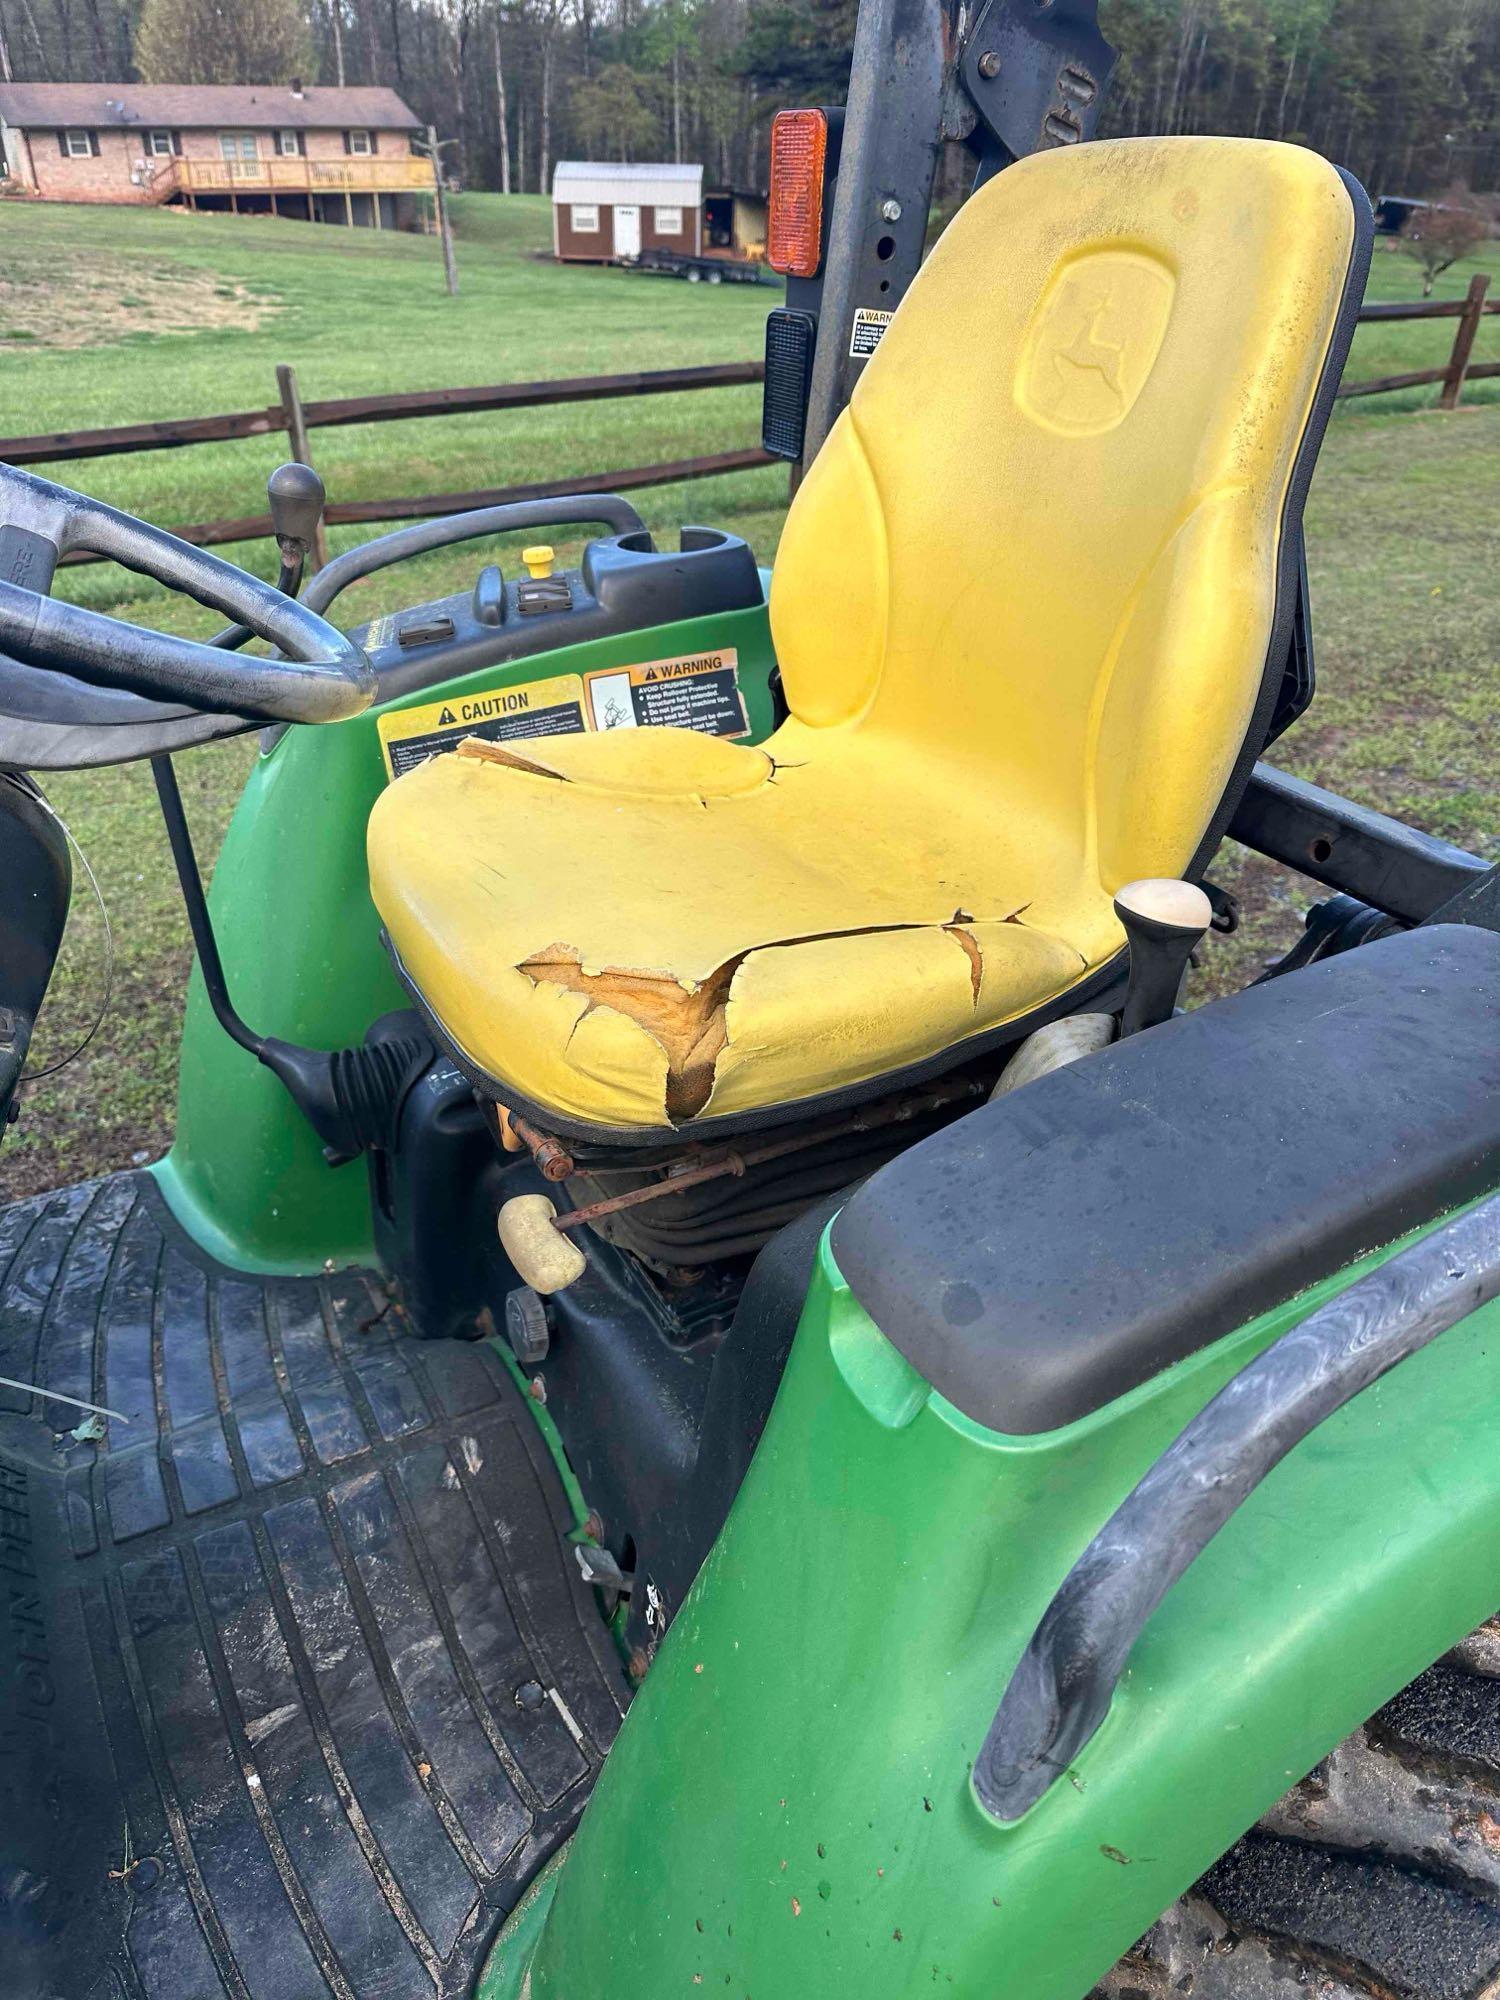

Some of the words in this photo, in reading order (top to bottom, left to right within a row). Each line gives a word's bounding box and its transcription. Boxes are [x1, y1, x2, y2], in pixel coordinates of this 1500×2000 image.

[866, 312, 892, 323] WARN
[661, 657, 722, 677] WARNING
[638, 685, 659, 694] AVOID
[659, 679, 694, 691] CRUSHING:
[645, 692, 663, 702] Keep
[662, 687, 688, 698] Rollover
[688, 682, 719, 693] Protective
[461, 691, 529, 721] CAUTION
[647, 697, 677, 708] Structure
[676, 695, 690, 705] fully
[689, 689, 720, 701] extended.
[648, 708, 658, 716] Do
[658, 706, 670, 715] not
[669, 703, 687, 713] jump
[690, 698, 718, 708] machine
[717, 696, 732, 705] tips.
[650, 715, 663, 723] Use
[663, 713, 678, 721] seat
[677, 710, 692, 719] belt.
[692, 715, 709, 723] must
